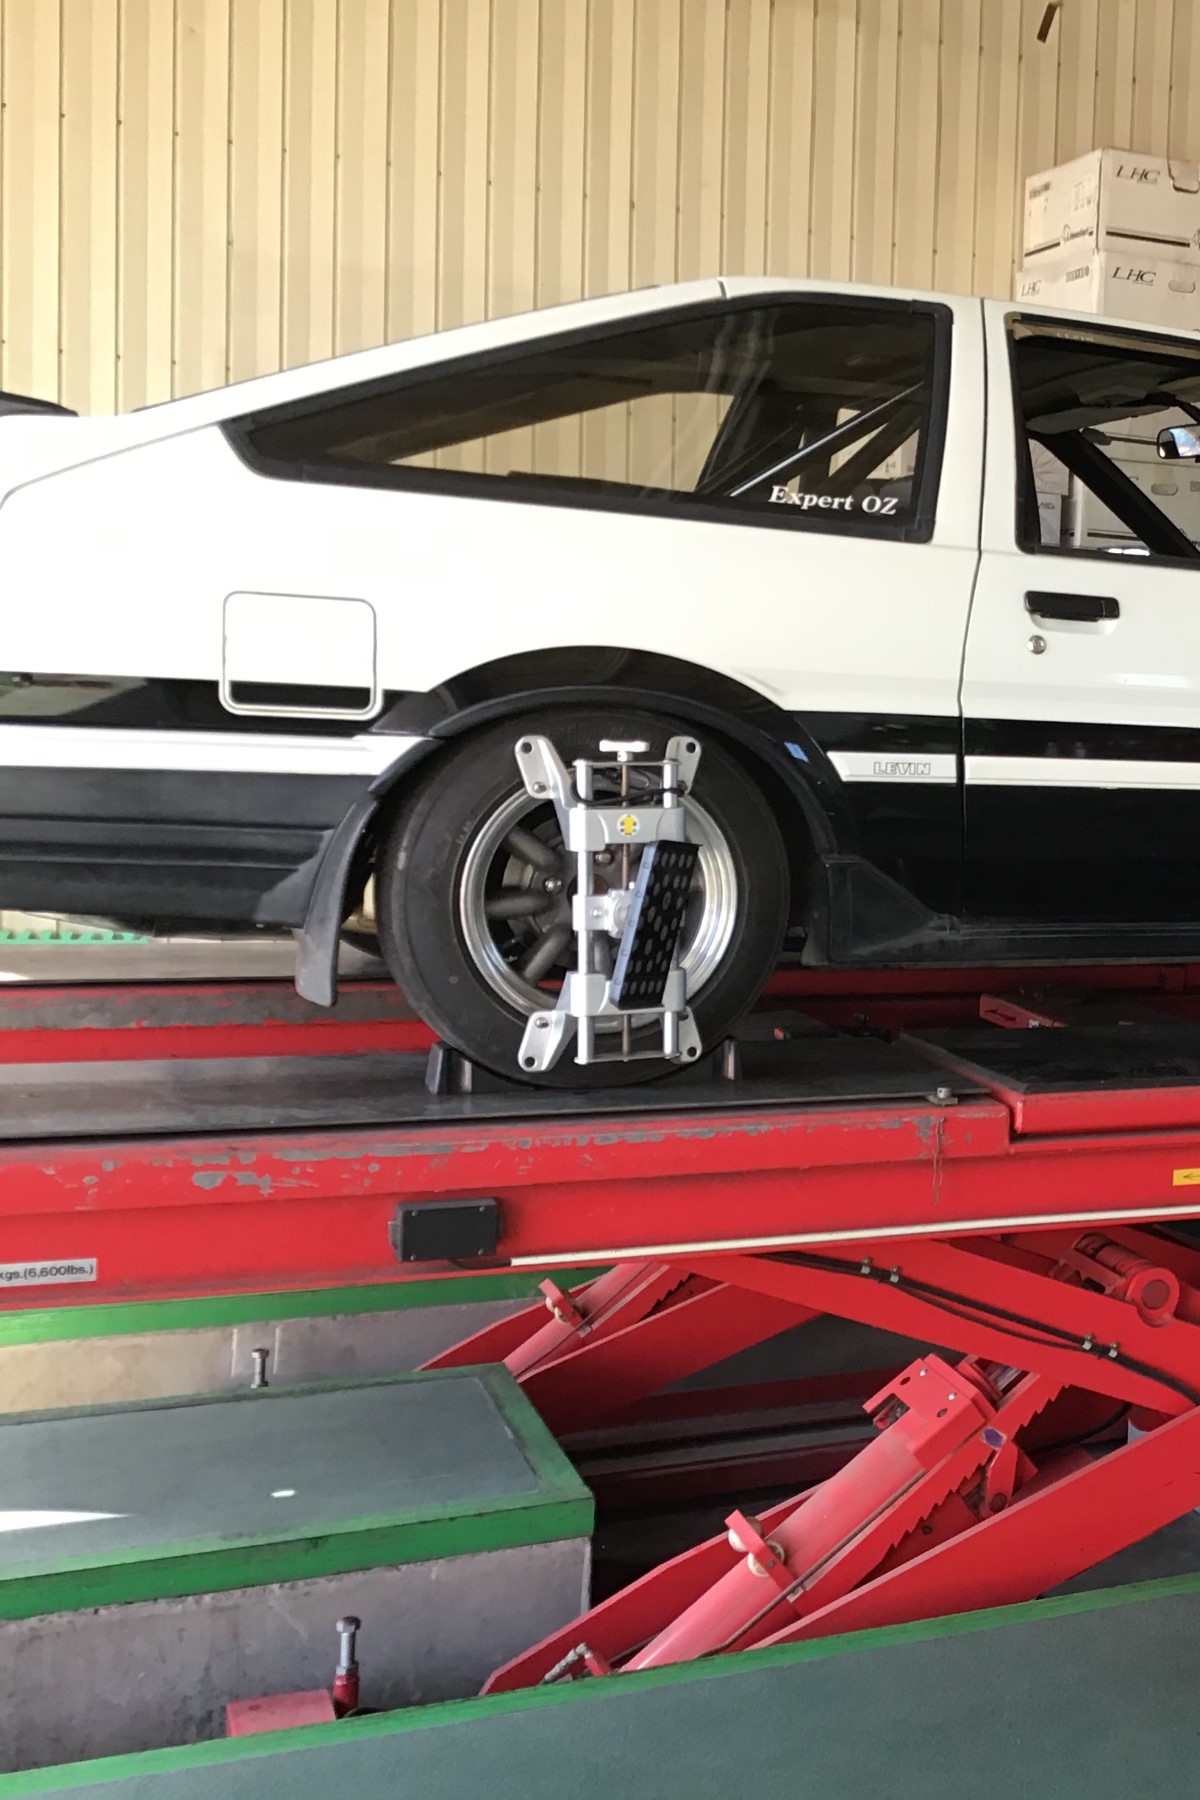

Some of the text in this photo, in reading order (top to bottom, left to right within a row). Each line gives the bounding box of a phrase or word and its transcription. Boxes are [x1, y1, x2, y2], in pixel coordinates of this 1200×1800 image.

[1112, 266, 1157, 284] LHC
[768, 485, 899, 516] Expert OZ
[873, 761, 931, 776] LEVIN
